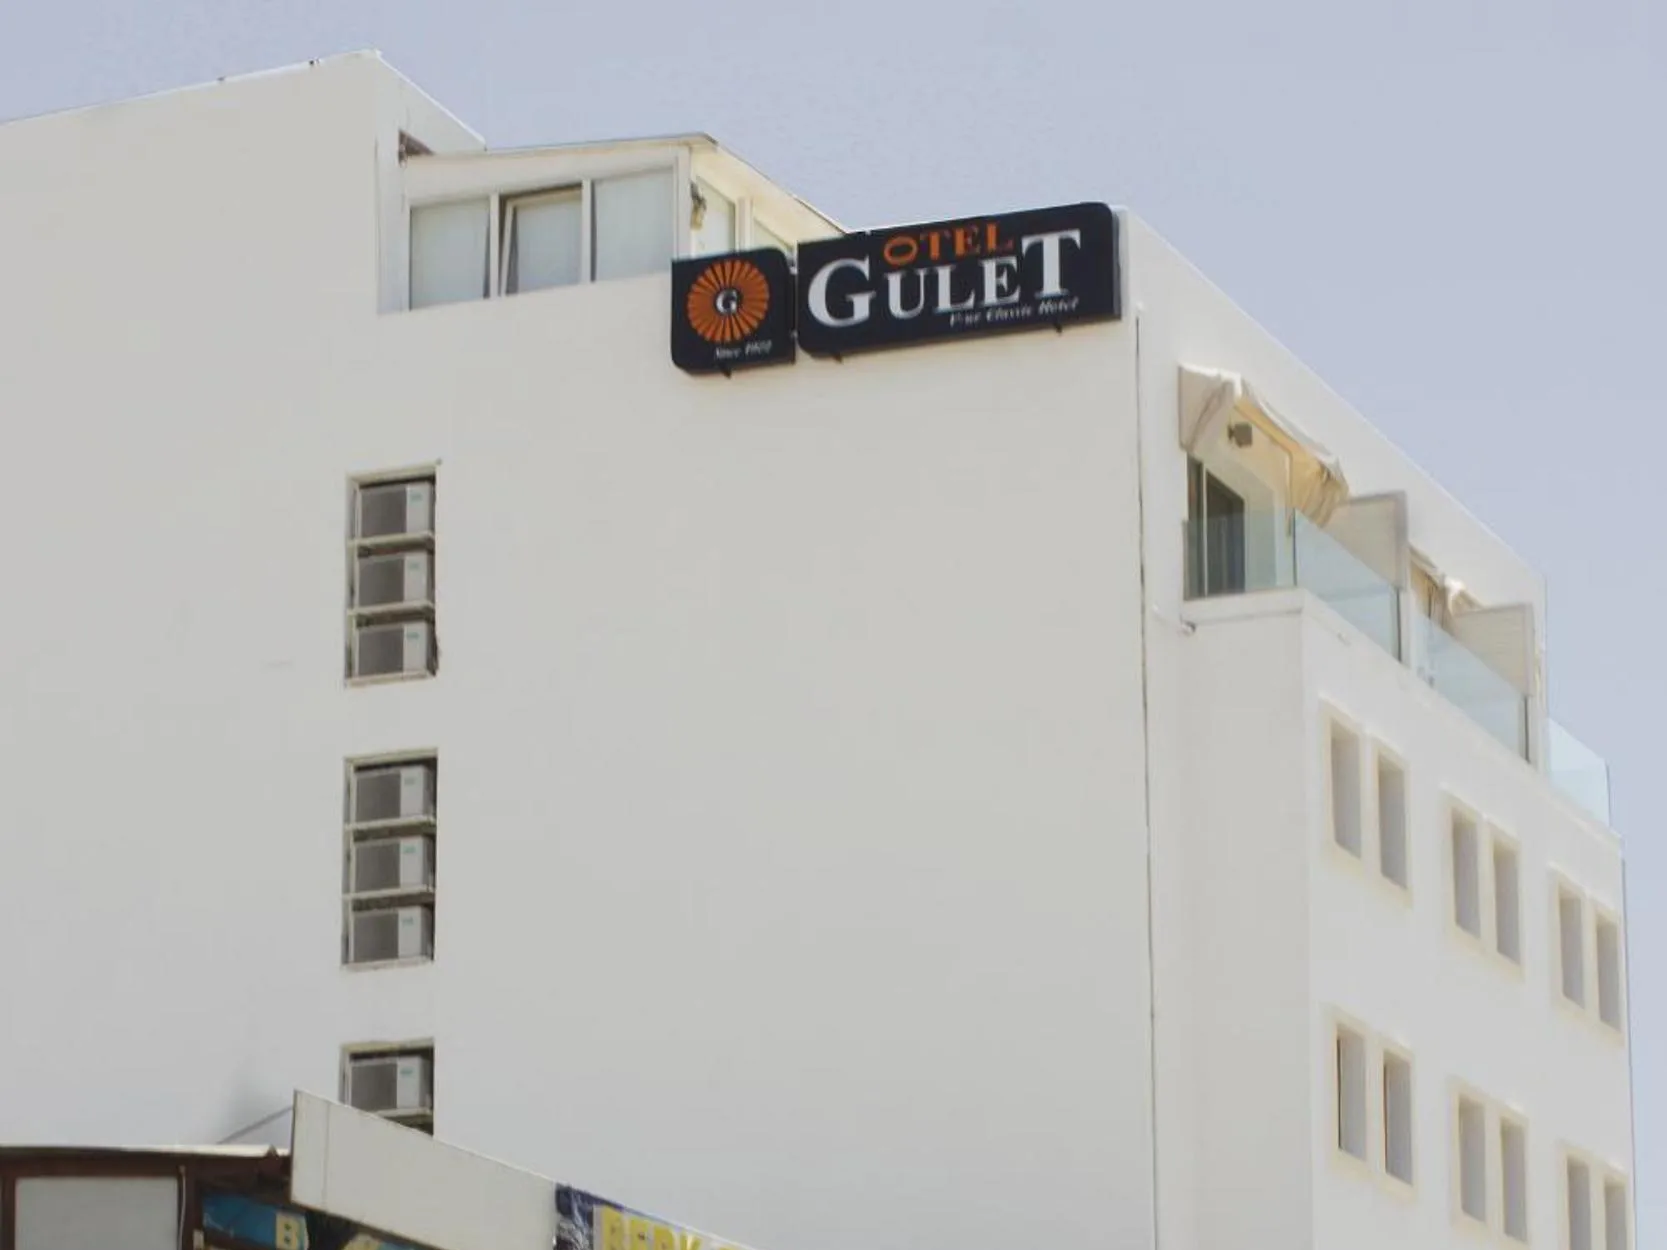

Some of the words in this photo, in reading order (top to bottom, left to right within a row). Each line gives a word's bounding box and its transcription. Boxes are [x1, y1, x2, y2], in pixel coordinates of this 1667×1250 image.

[883, 221, 1015, 266] OTEL
[807, 229, 1081, 328] GULET
[716, 289, 738, 314] G
